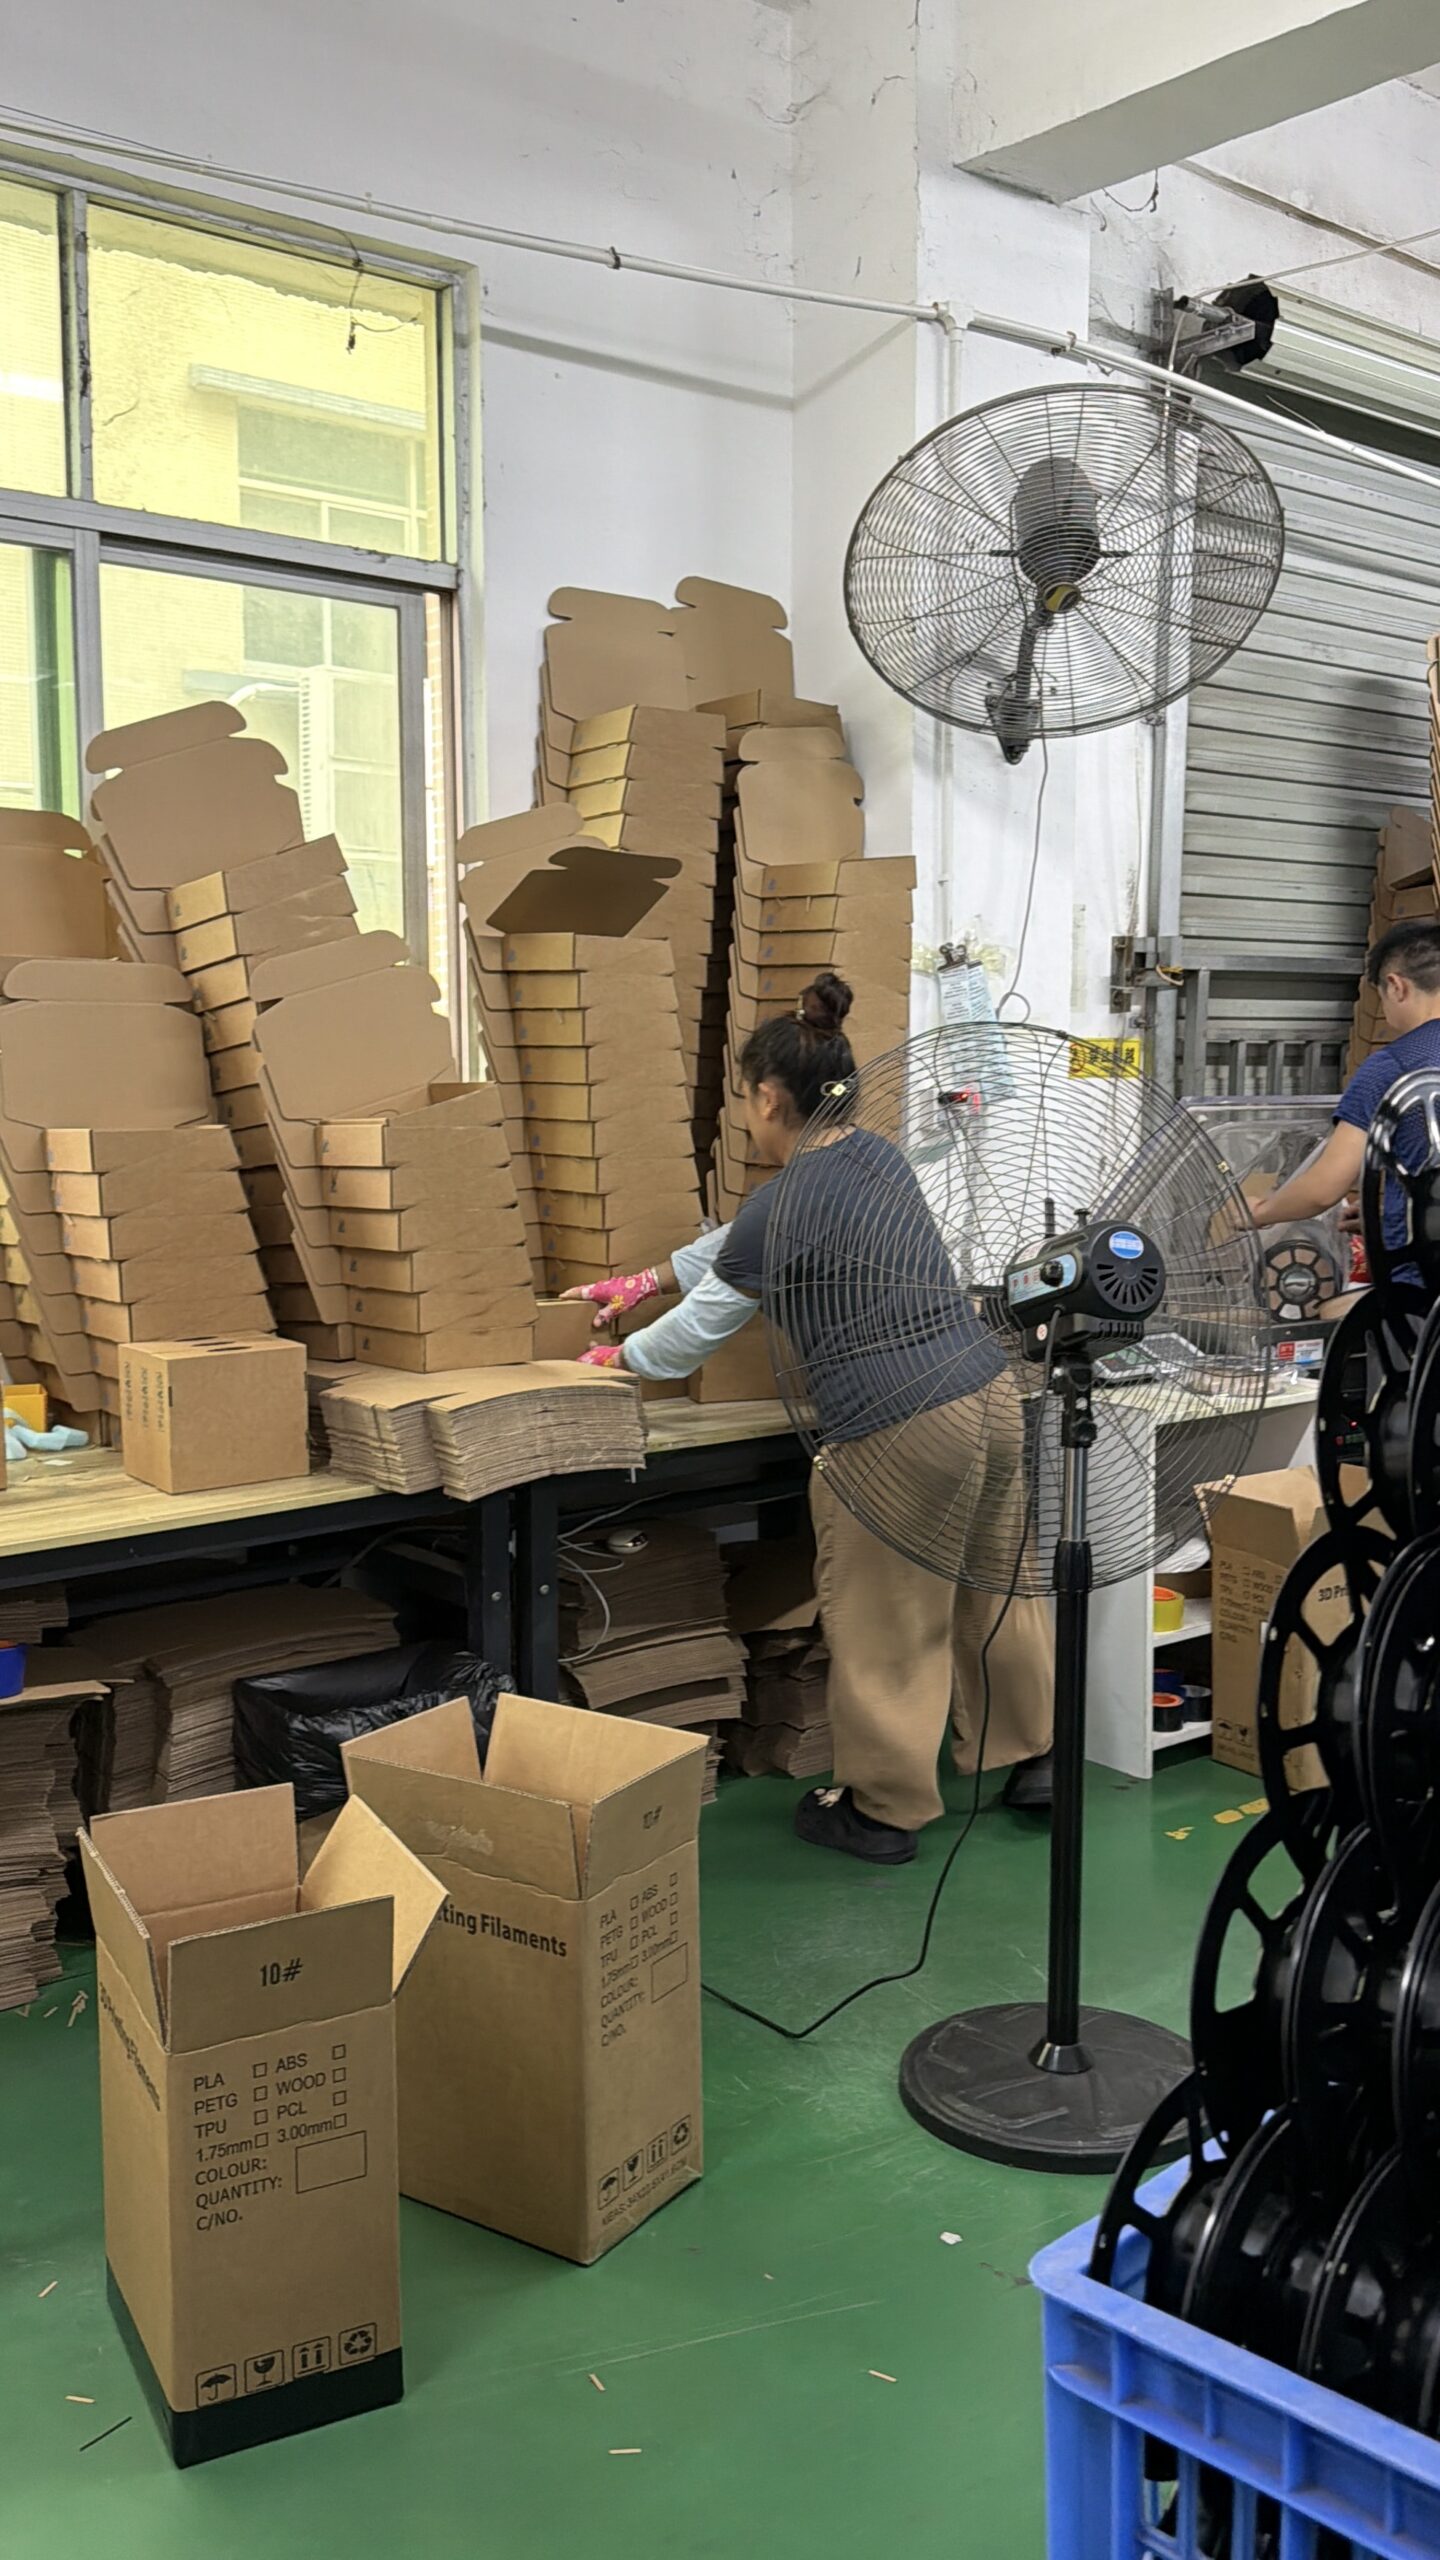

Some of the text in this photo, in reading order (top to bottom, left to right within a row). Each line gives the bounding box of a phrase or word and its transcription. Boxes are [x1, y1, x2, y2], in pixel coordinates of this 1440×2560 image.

[438, 1904, 568, 1958] ting Filaments
[260, 1957, 304, 1987] 10#
[193, 2053, 309, 2092] PLA ABS
[194, 2072, 327, 2115] PETG WOOD
[194, 2101, 308, 2139] TPU PCL
[195, 2119, 333, 2163] 1.75mm 3.00mm
[194, 2157, 267, 2186] COLOUR:
[195, 2175, 283, 2210] QUANTITY:
[196, 2208, 244, 2232] C/NO.
